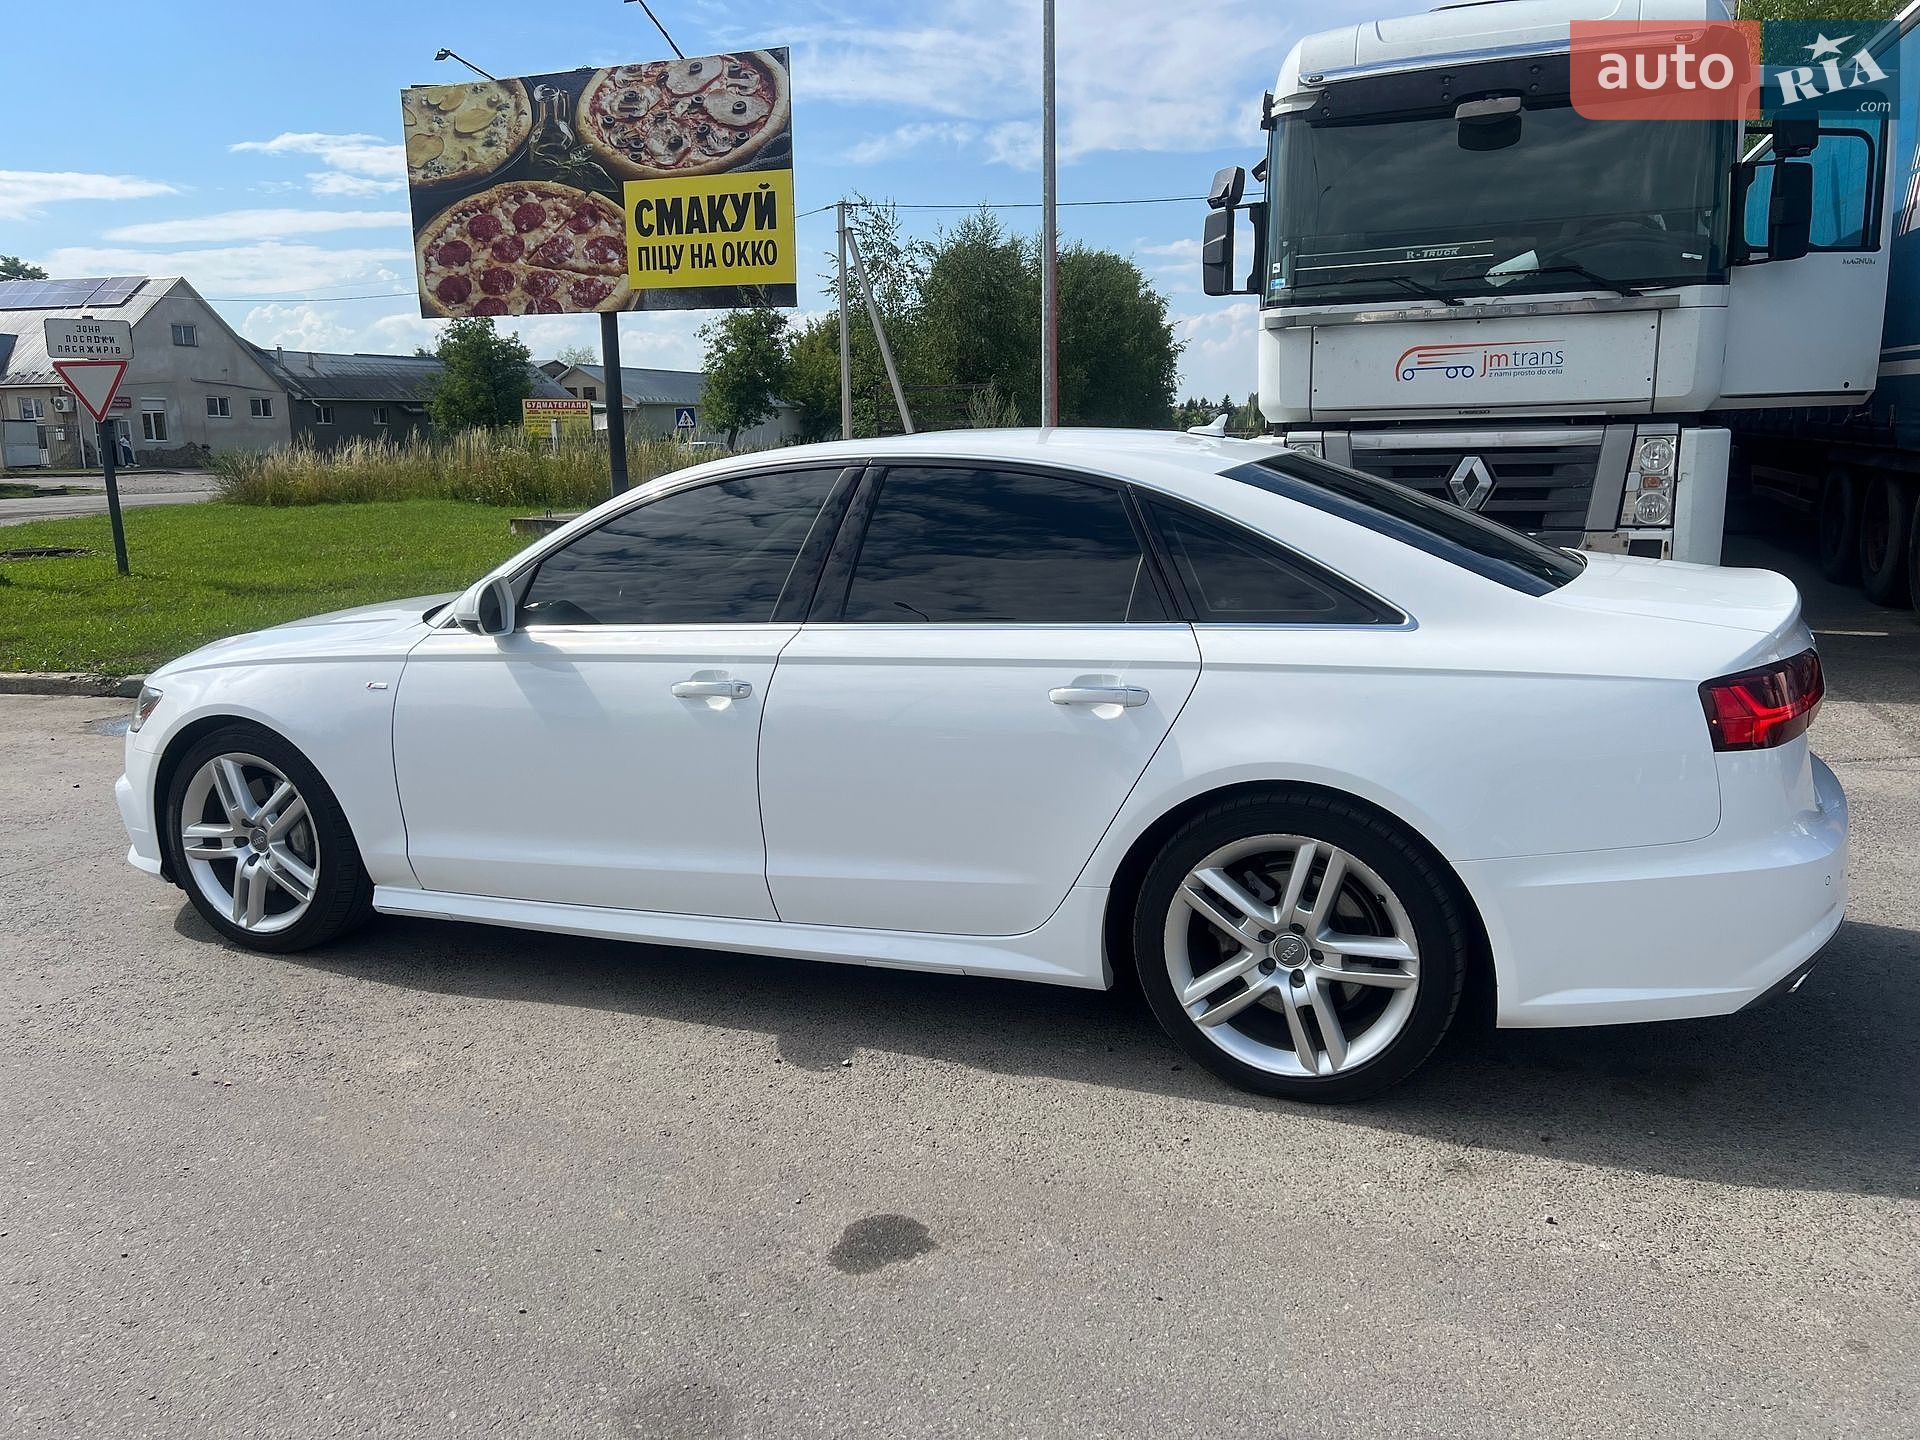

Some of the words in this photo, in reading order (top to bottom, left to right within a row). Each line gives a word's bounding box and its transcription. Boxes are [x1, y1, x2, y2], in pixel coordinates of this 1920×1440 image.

[634, 182, 777, 237] СМАКУЙ
[637, 244, 685, 274] ПІЦУ
[690, 243, 717, 269] НА
[721, 239, 778, 268] ОККО
[1406, 246, 1461, 260] R-TRUCK
[76, 324, 101, 333] ЗОНА
[65, 334, 116, 344] ПОСАДКИ
[57, 344, 121, 354] ПАСАЖИРІВ
[1513, 370, 1535, 379] prosto
[1548, 368, 1563, 376] celu
[526, 401, 587, 409] БУДМАТЕРІАЛИ
